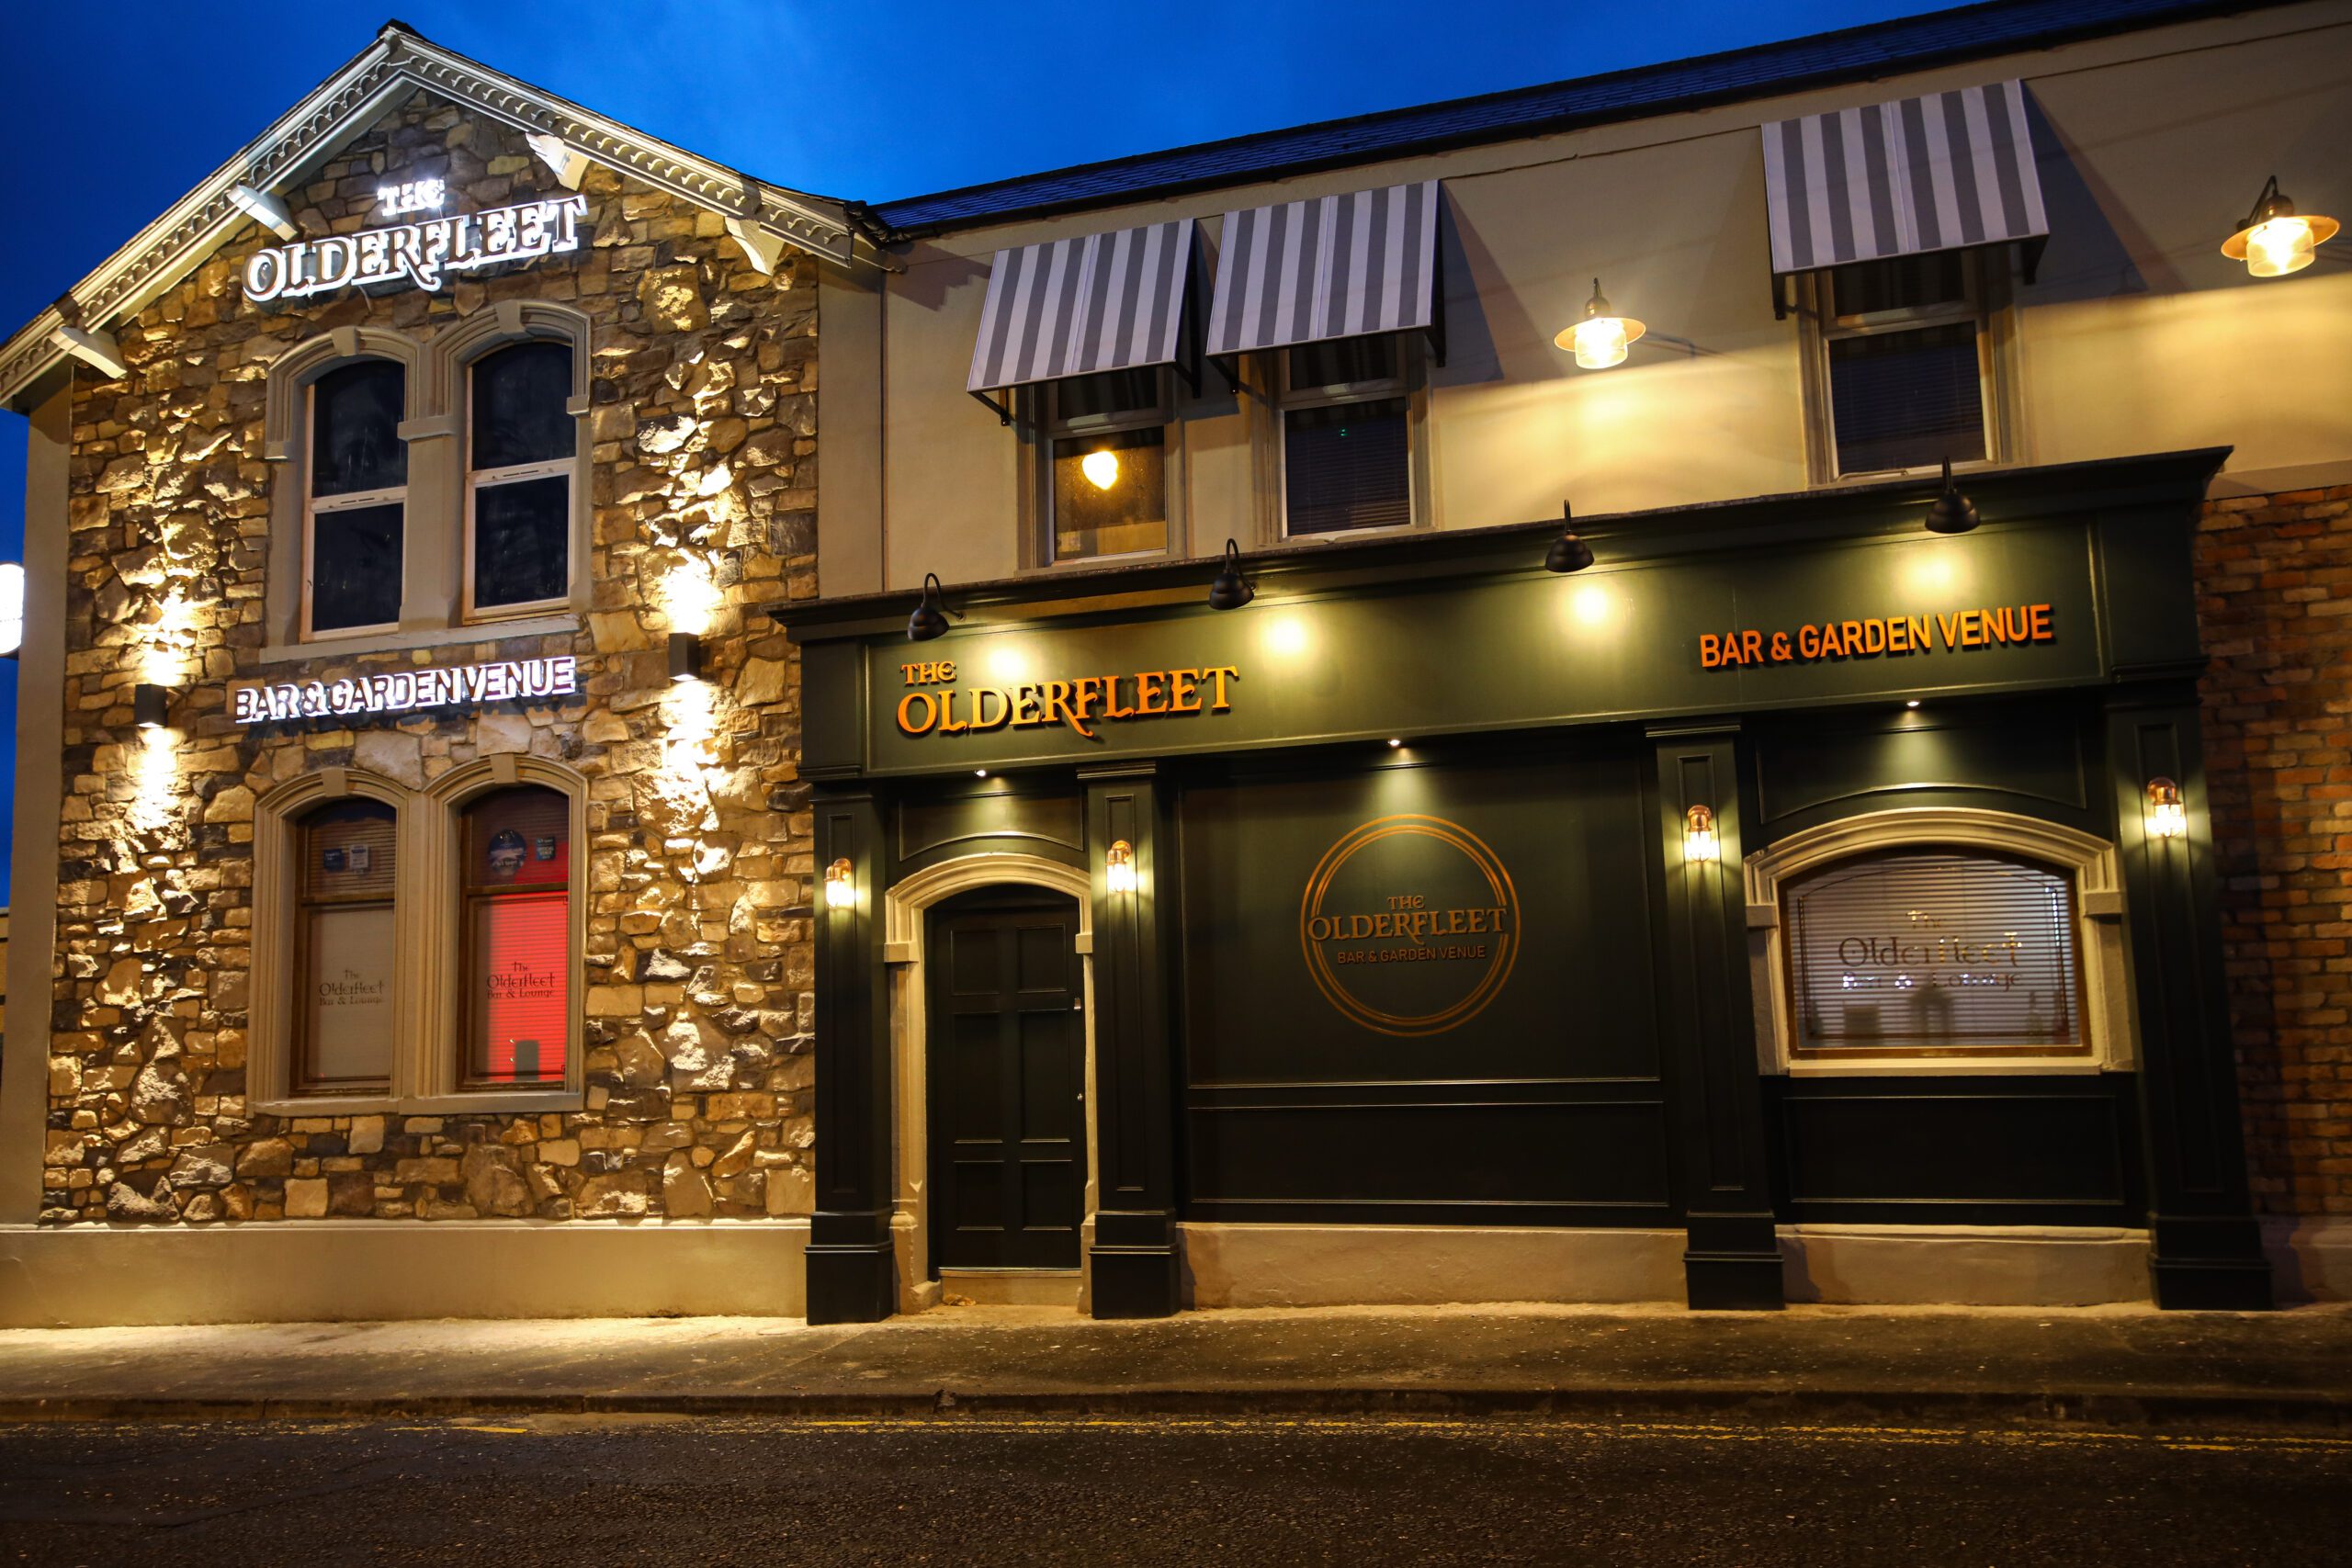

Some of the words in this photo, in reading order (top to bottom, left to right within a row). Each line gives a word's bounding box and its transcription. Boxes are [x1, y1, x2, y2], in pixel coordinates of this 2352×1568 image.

[242, 194, 588, 301] OLDERFLEET
[1700, 630, 1764, 668] BAR
[1770, 631, 1793, 661] &
[1799, 614, 1931, 659] GARDEN
[1937, 604, 2052, 648] VENUE
[235, 683, 300, 723] BAR
[301, 681, 327, 716] &
[328, 667, 461, 715] GARDEN
[461, 656, 576, 702] VENUE
[901, 660, 956, 685] THE
[897, 665, 1238, 738] OLDERFLEET
[1307, 908, 1508, 945] OLDERFLEET
[1387, 896, 1425, 910] THE
[1338, 951, 1365, 964] BAR
[1368, 950, 1377, 963] &
[1380, 947, 1436, 962] GARDEN
[1439, 945, 1486, 959] VENUE
